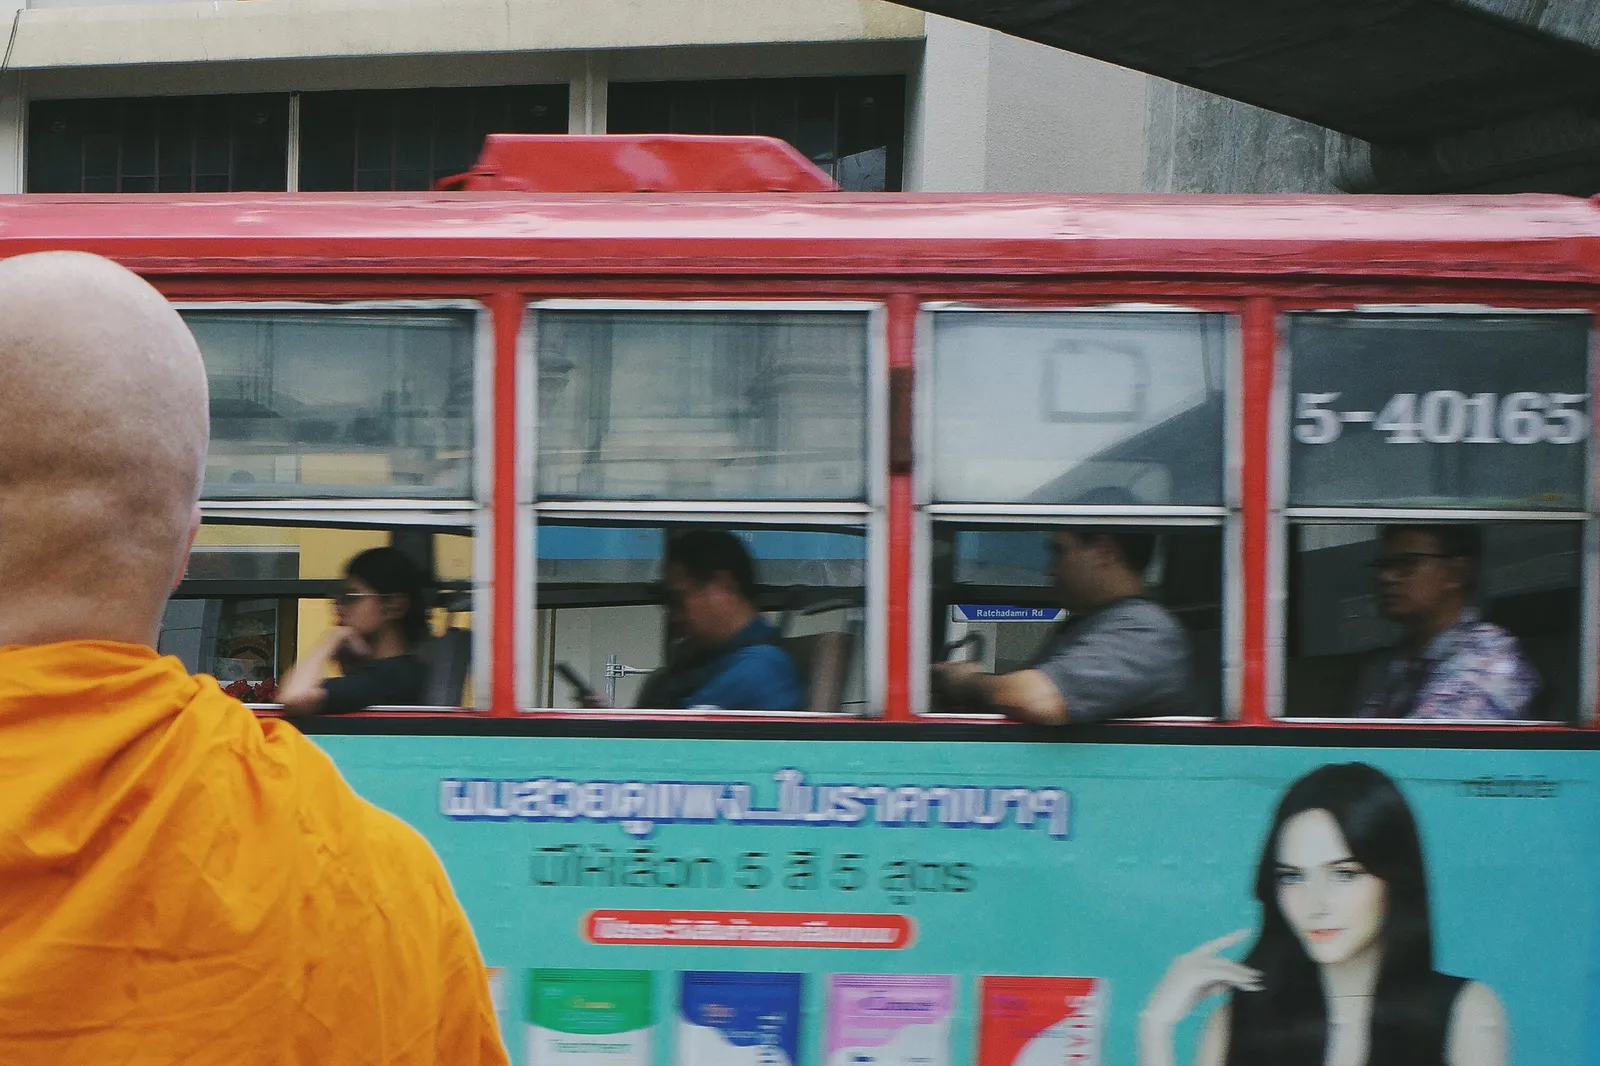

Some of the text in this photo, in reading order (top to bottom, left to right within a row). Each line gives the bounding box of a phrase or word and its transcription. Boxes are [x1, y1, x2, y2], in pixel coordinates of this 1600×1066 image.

[1292, 389, 1589, 445] 5-40165
[976, 608, 1028, 618] Ratchadamri
[735, 848, 771, 890] 5
[829, 851, 869, 892] 5
